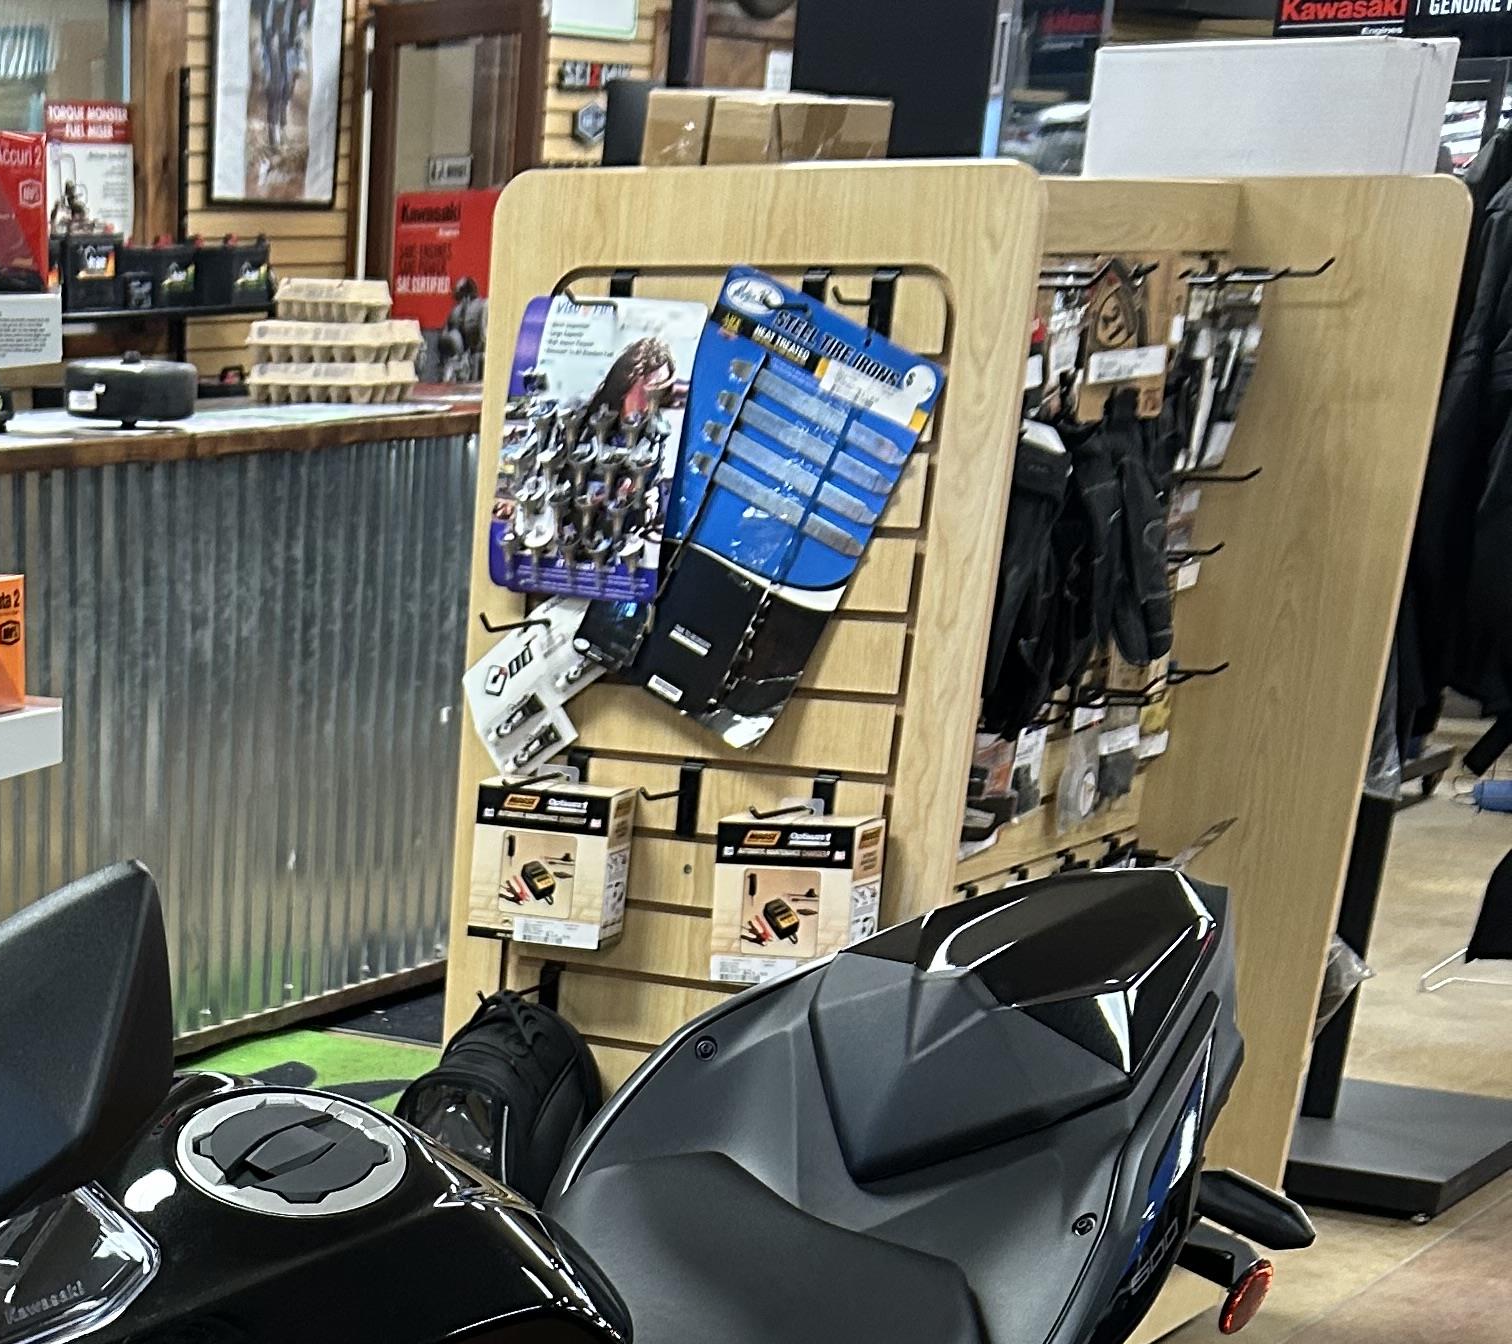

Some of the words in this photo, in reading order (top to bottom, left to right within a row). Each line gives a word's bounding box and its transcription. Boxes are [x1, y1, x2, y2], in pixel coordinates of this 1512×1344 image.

[1281, 0, 1407, 21] Kawasaki
[1429, 0, 1502, 15] GENUINE
[34, 144, 43, 166] 2
[773, 310, 821, 348] STEEL
[819, 333, 854, 364] TIRE
[852, 351, 903, 387] IRONS
[13, 588, 20, 607] 2
